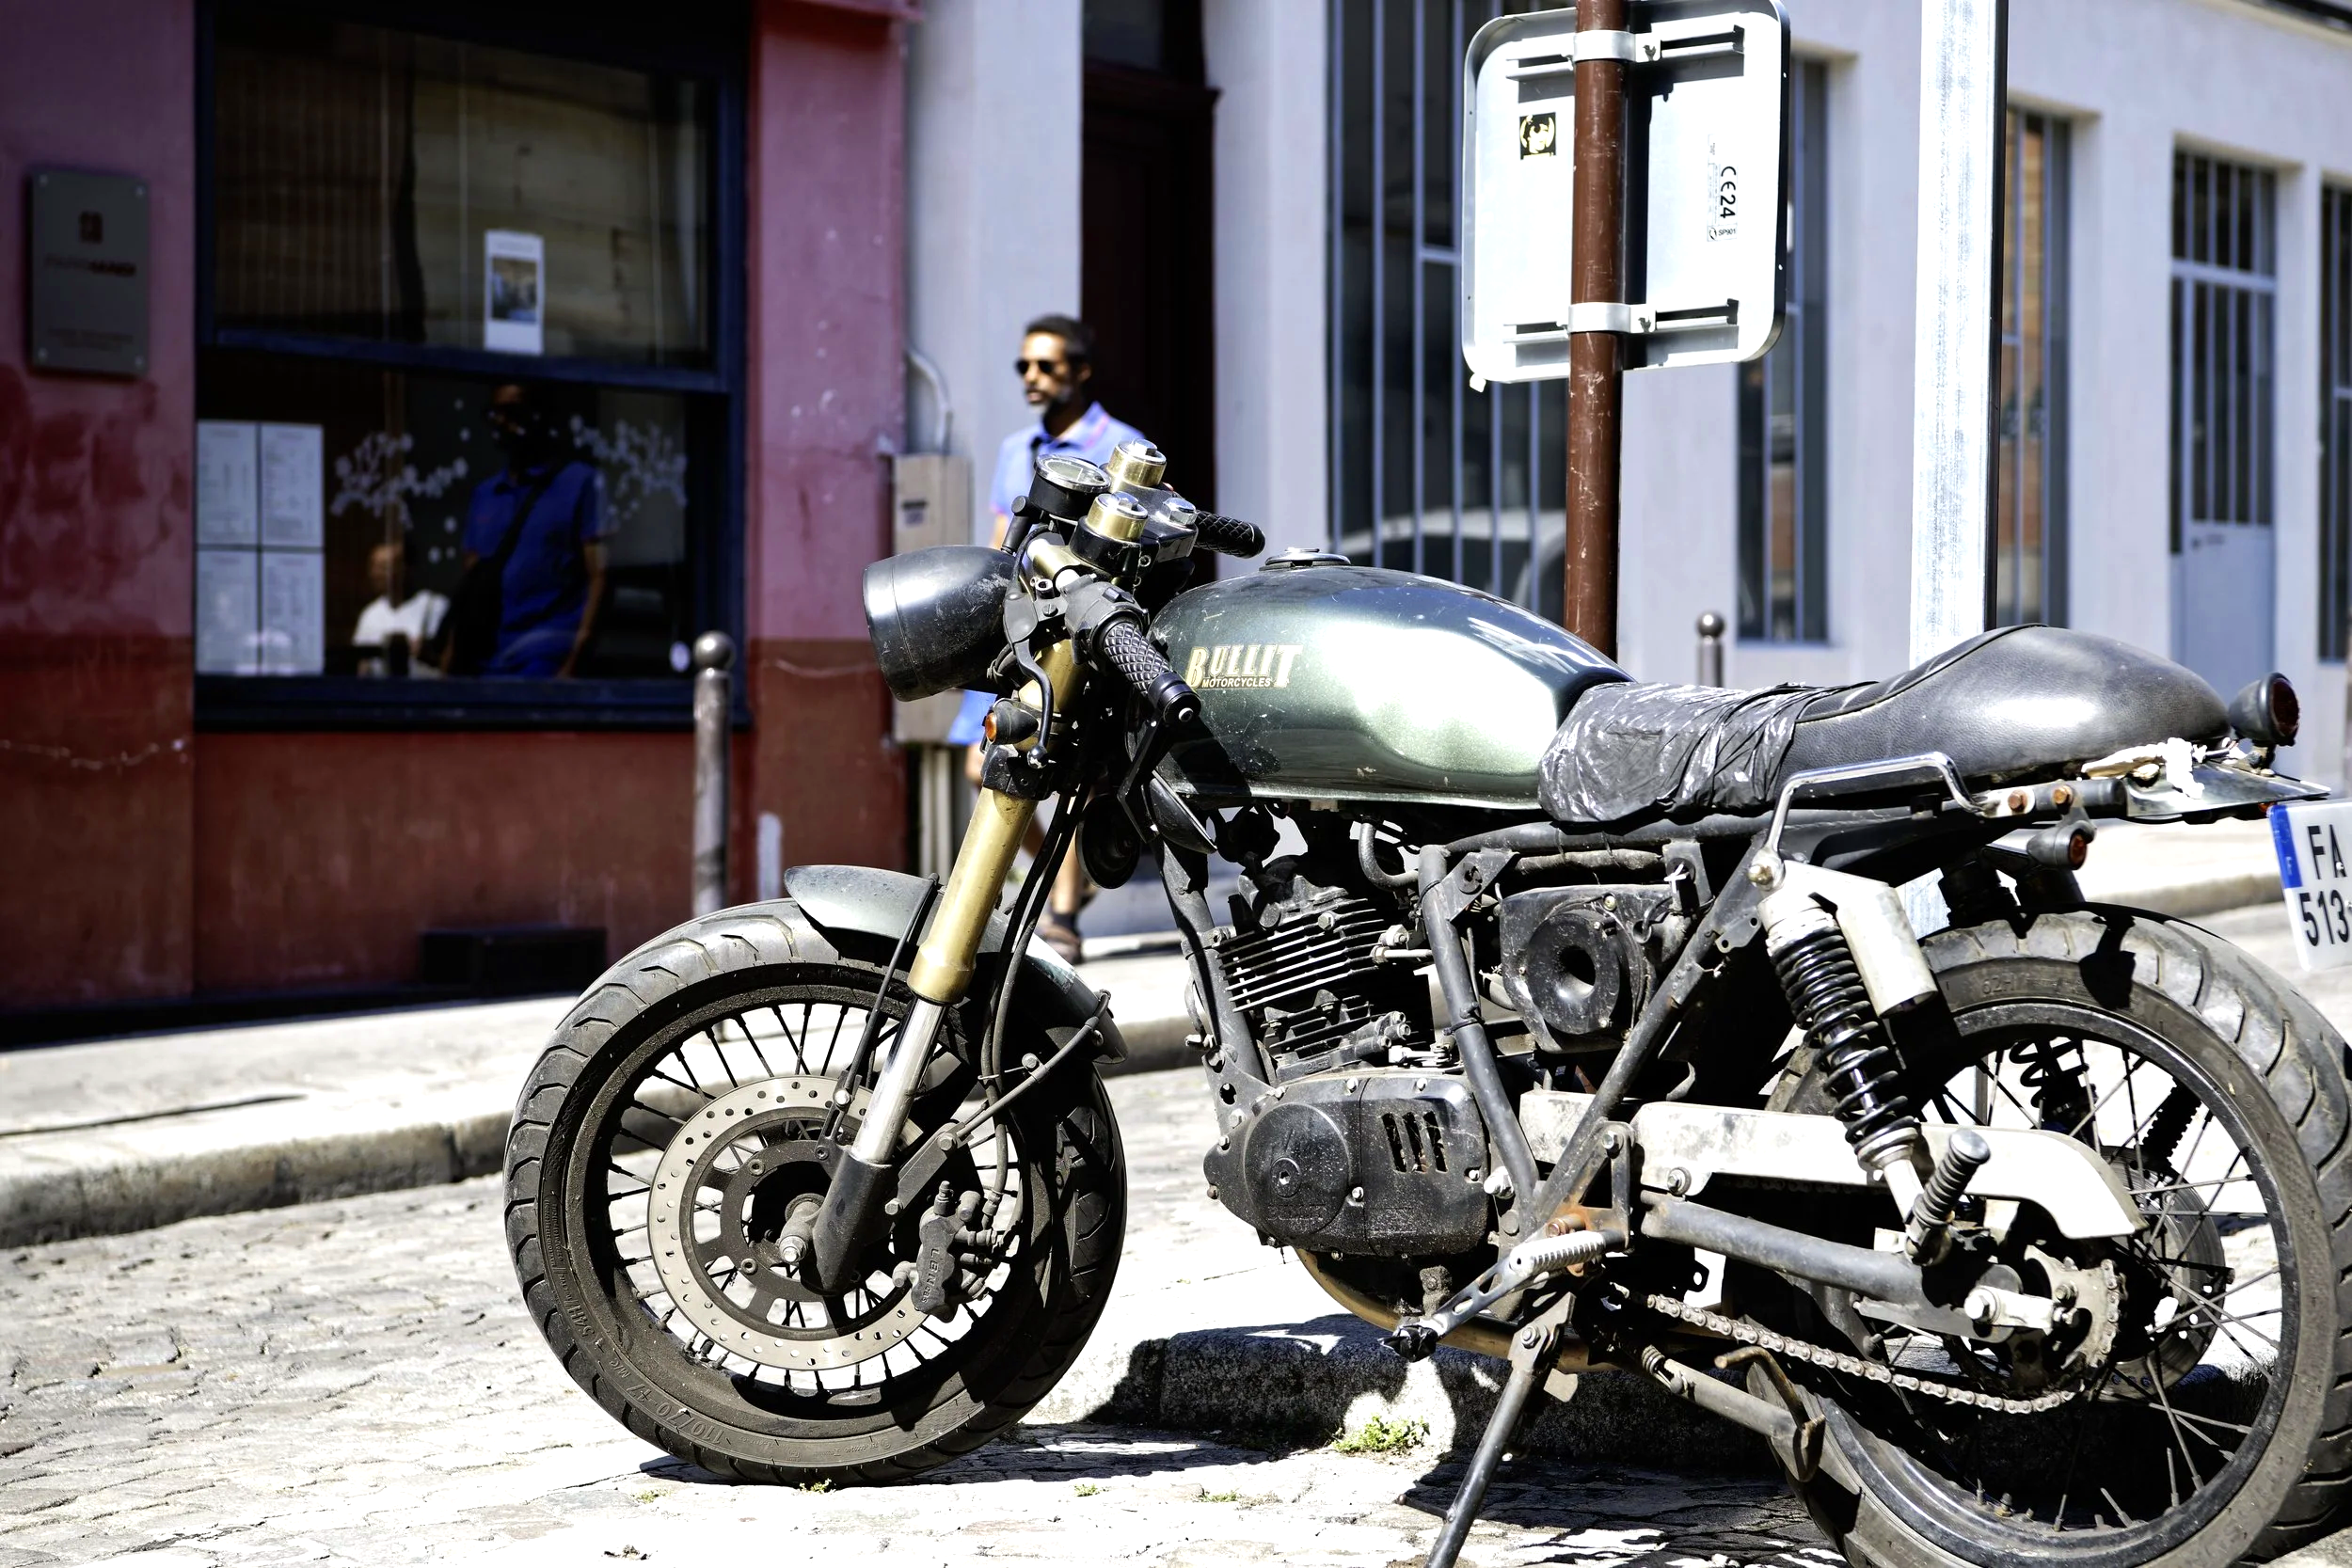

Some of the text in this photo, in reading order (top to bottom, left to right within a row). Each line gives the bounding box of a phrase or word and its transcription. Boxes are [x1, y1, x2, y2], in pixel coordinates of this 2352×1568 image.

[1185, 643, 1304, 689] BULLIT
[1201, 677, 1272, 689] MOTORCYCLES
[2307, 824, 2348, 879] FA
